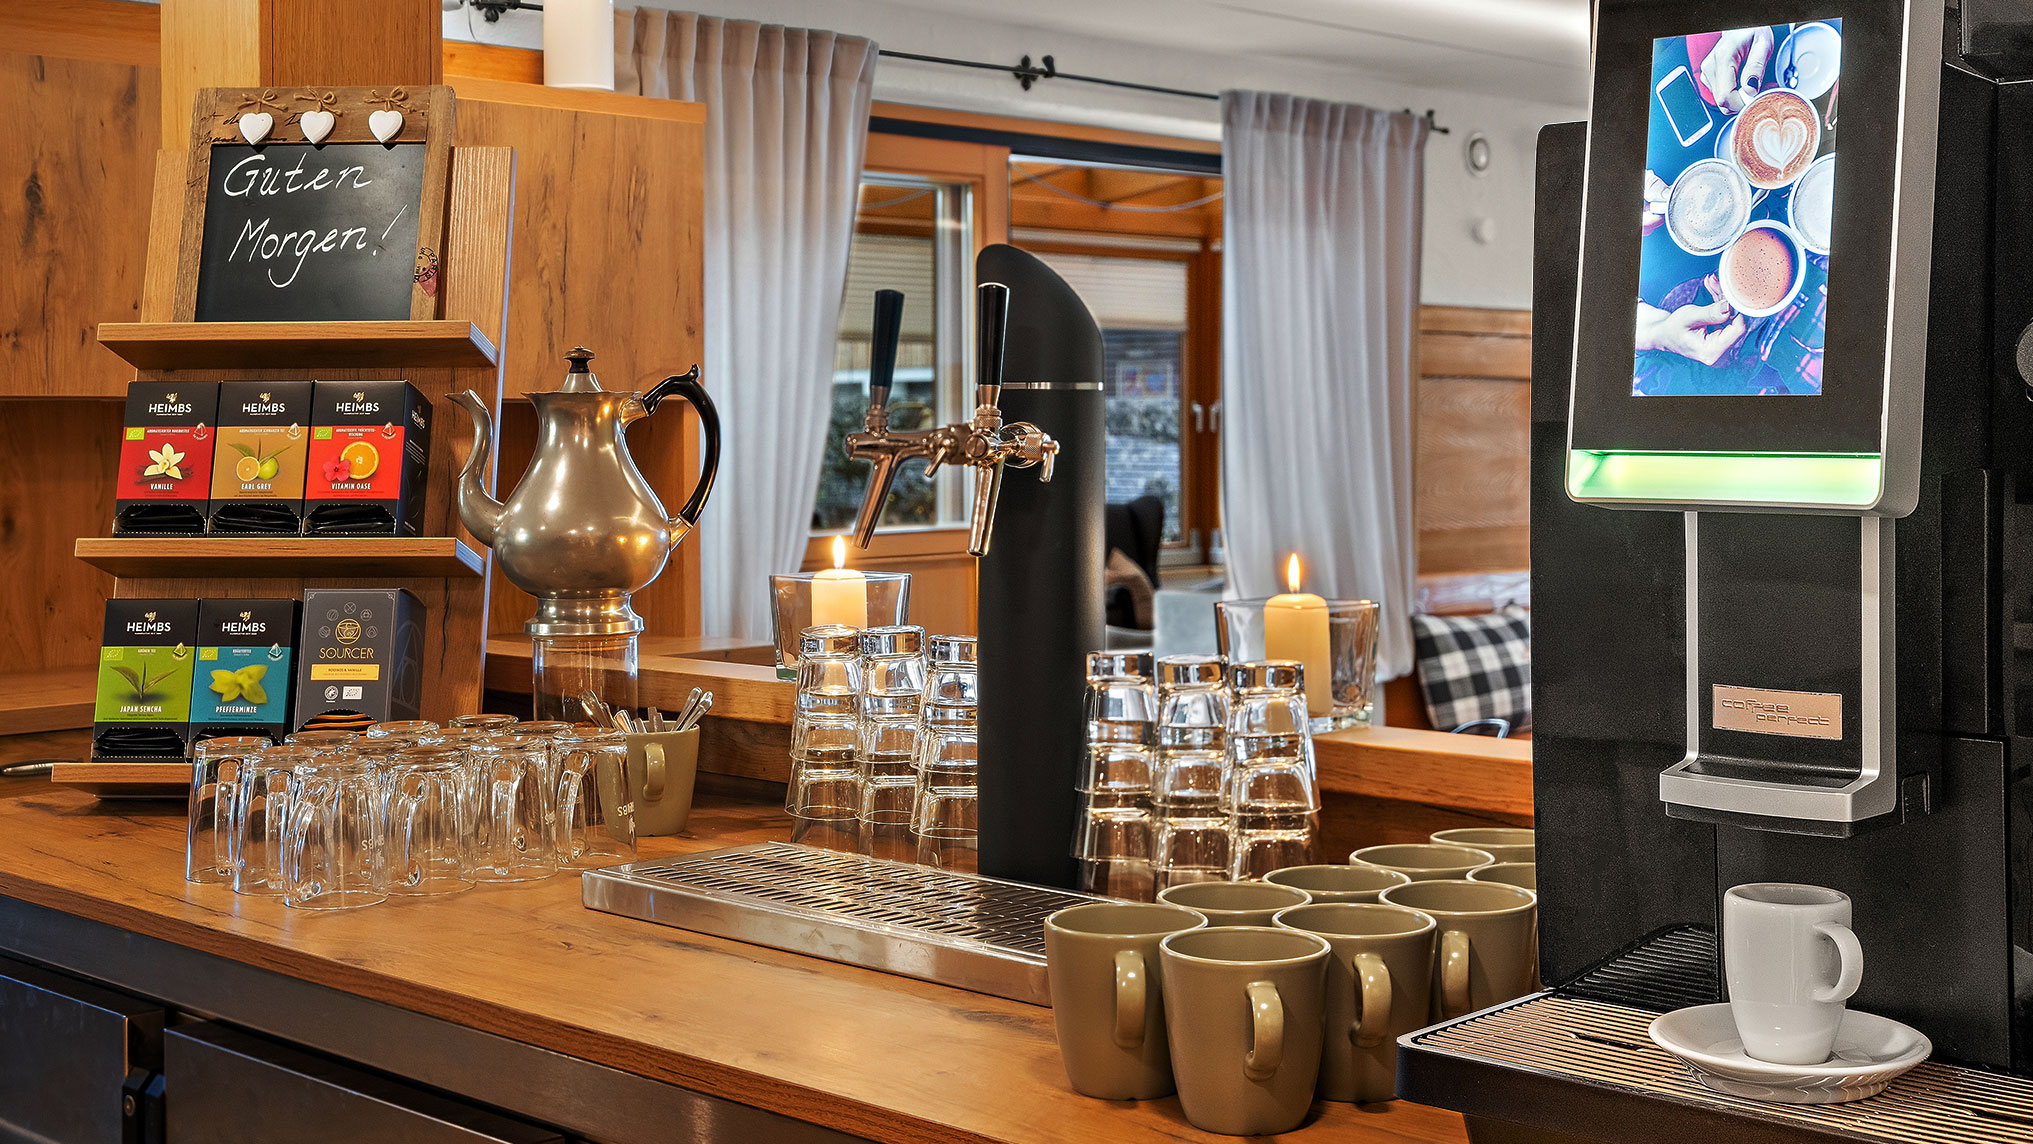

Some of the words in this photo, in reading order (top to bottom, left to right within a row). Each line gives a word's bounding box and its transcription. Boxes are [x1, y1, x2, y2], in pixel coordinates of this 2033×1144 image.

[223, 152, 373, 197] Guten
[228, 204, 408, 288] Morgen!
[148, 403, 192, 413] HEIMBS
[242, 402, 286, 413] HEIMBS
[336, 402, 380, 412] HEIMBS
[126, 622, 171, 632] HEIMBS
[221, 622, 266, 632] HEIMBS
[319, 647, 375, 660] SOURCER
[215, 705, 257, 713] PFEFFERMINZE
[1721, 699, 1789, 713] coffee
[1756, 713, 1830, 725] perfect
